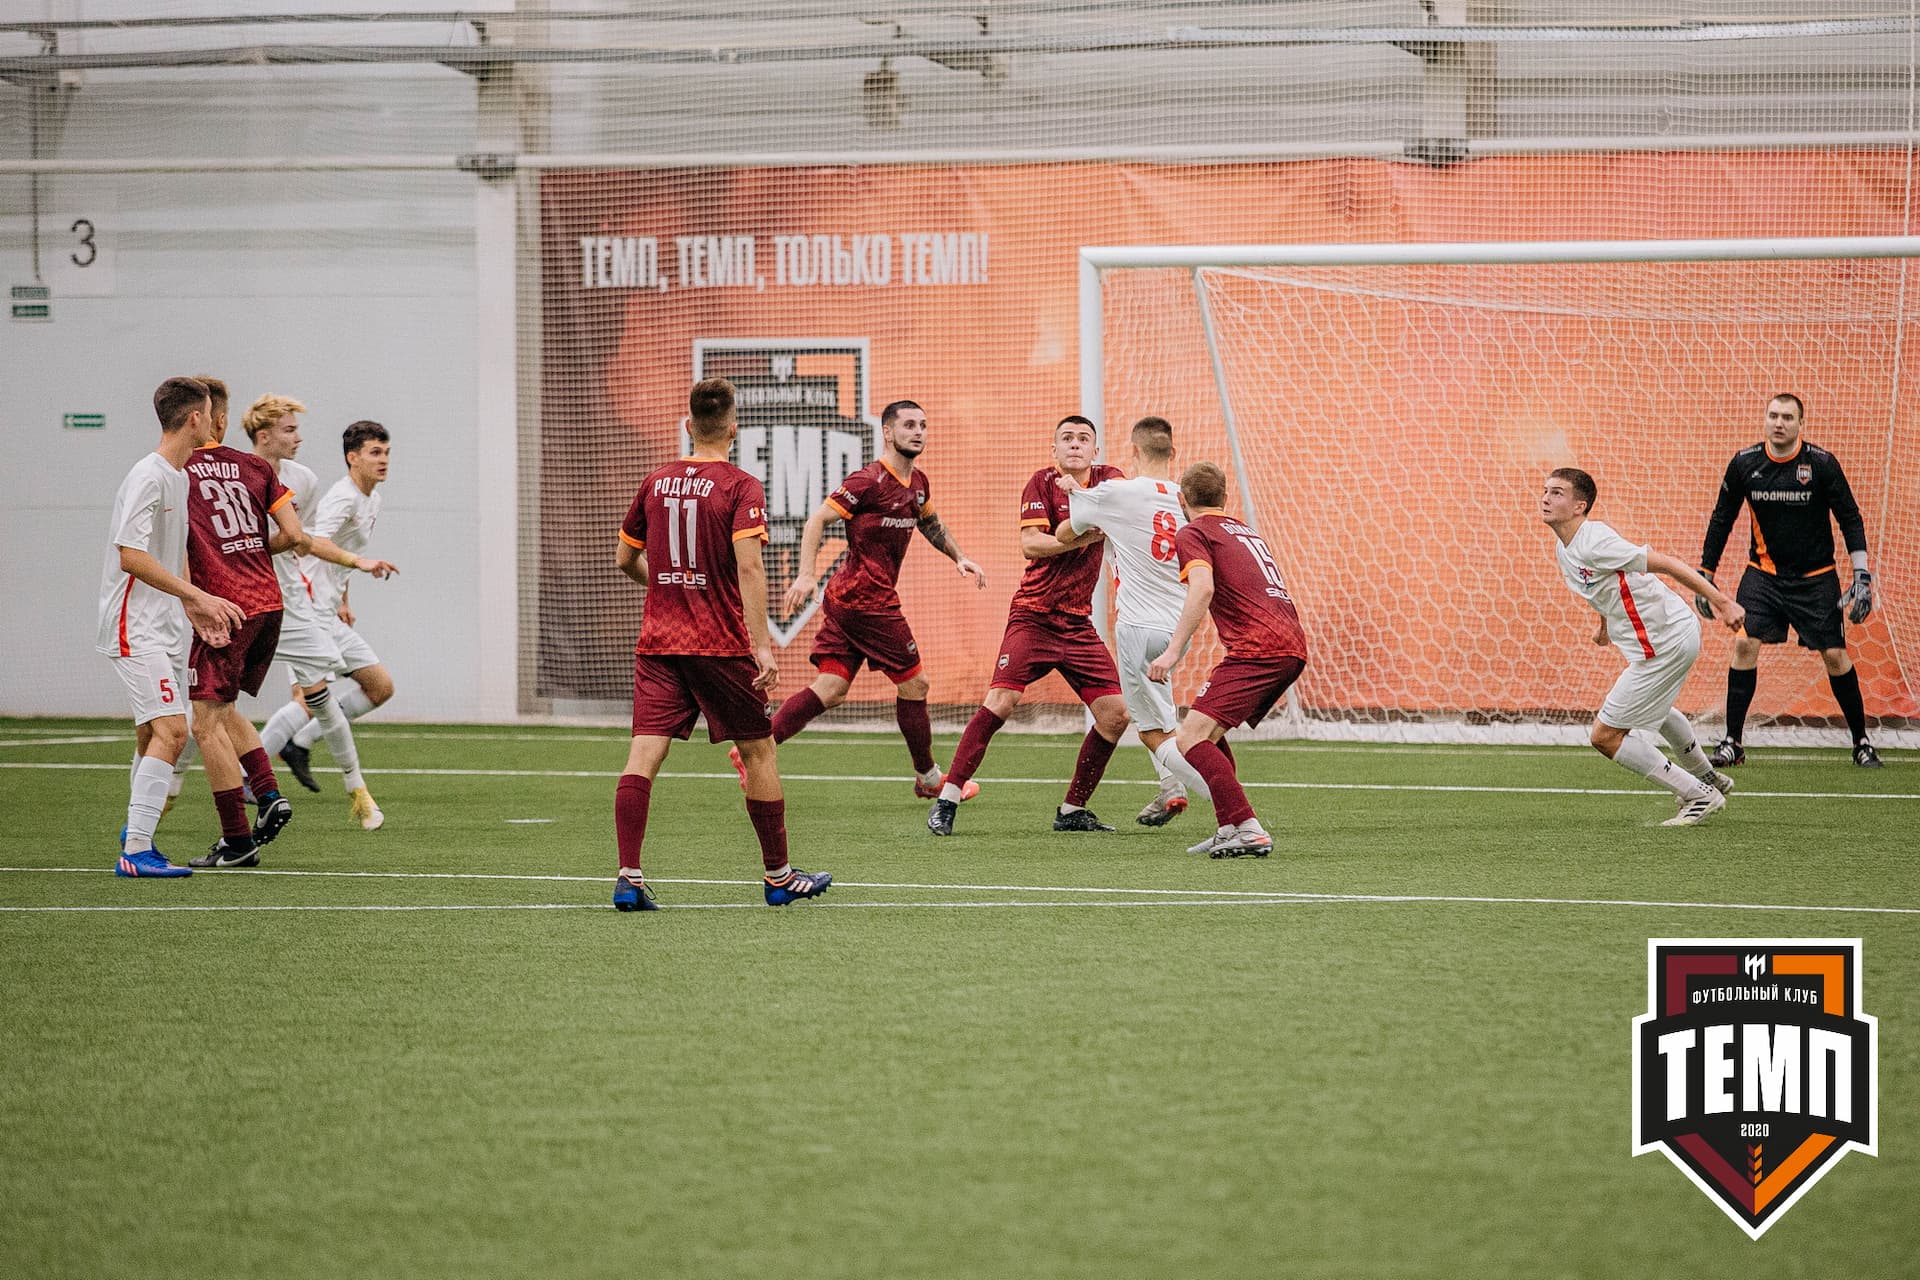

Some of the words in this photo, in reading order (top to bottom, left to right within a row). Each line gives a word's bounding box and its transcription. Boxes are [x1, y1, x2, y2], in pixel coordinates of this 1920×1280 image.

[70, 219, 98, 268] 3
[580, 236, 668, 293] ТЕМП,
[677, 235, 766, 293] ТЕМП,
[774, 233, 891, 286] ТОЛЬКО
[902, 231, 990, 285] ТЕМП!
[188, 462, 241, 480] ЧЕРНОВ
[653, 476, 715, 498] РОДИЧЕВ
[736, 423, 864, 518] ЕМП
[199, 479, 260, 539] 30
[663, 496, 698, 569] 11
[220, 536, 264, 554] SEUS
[1151, 510, 1177, 562] 8
[657, 571, 707, 586] SEUS
[159, 678, 175, 704] 5
